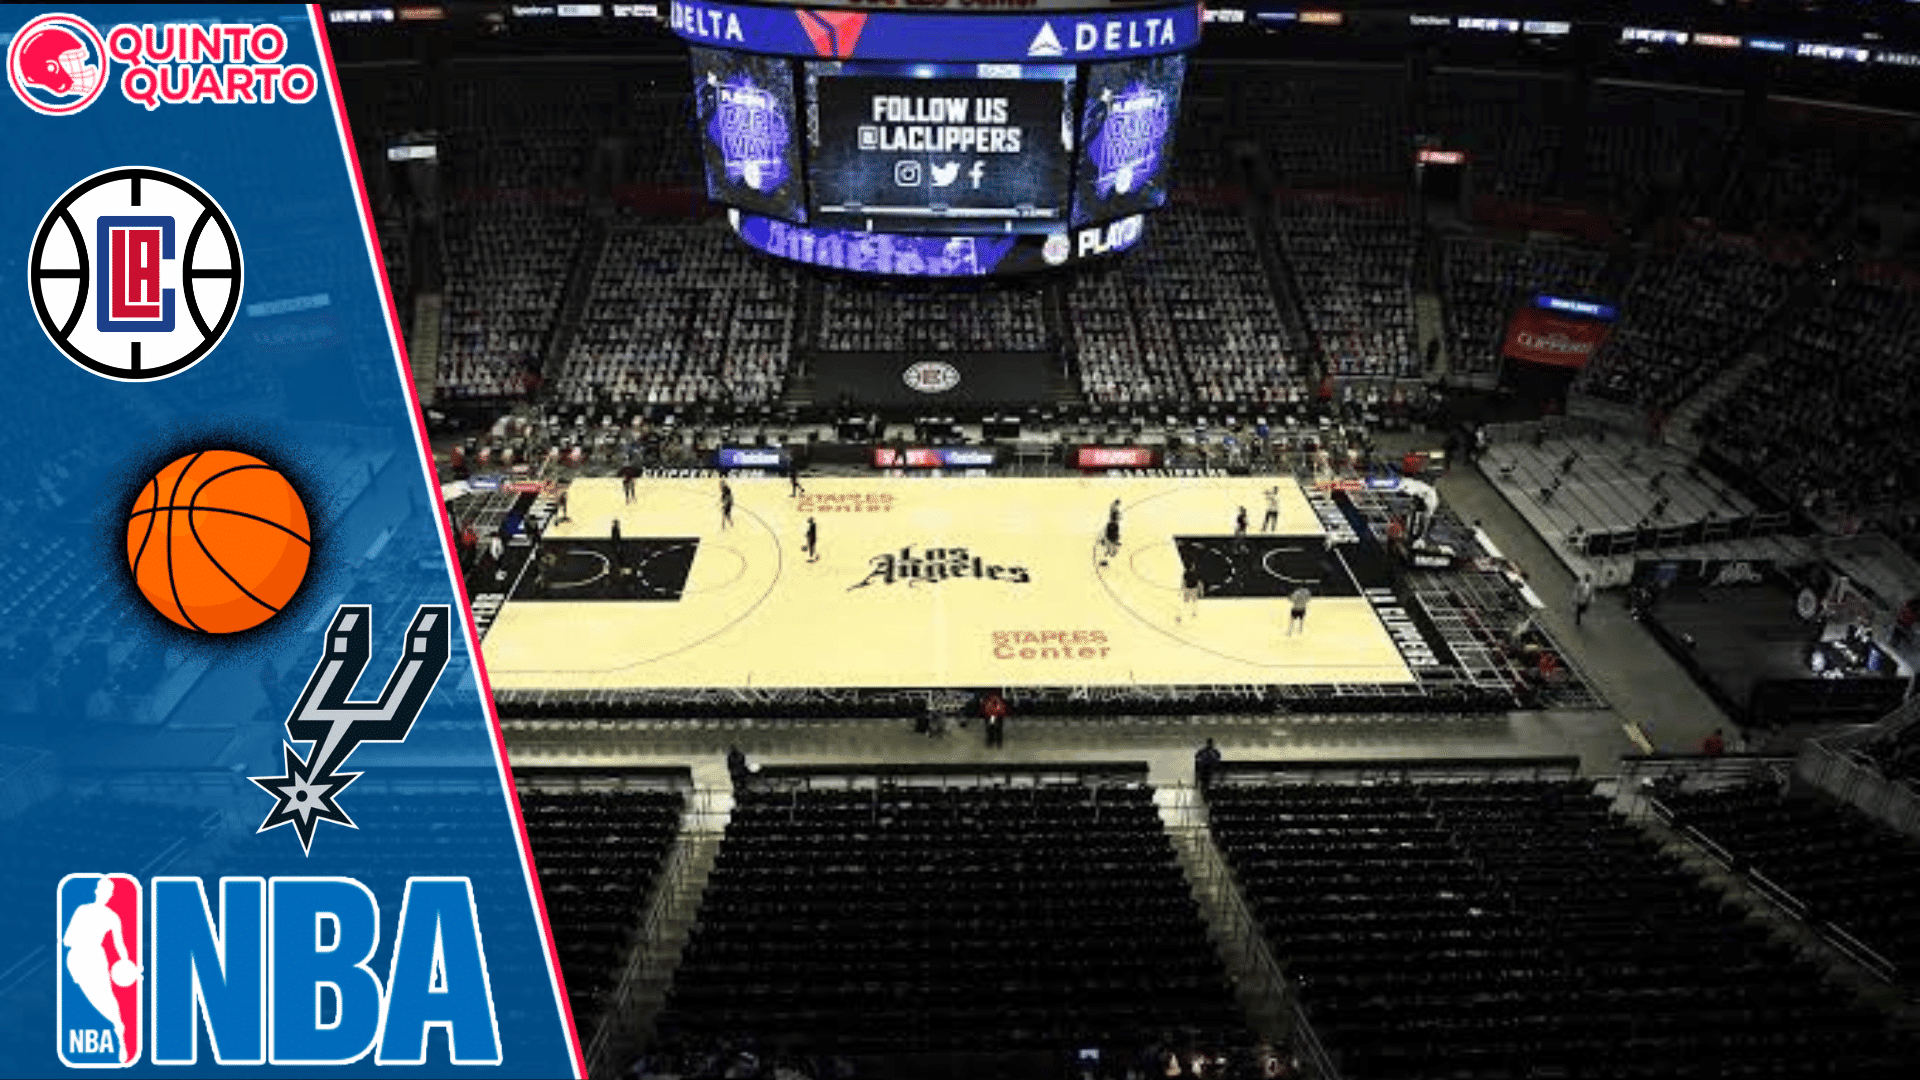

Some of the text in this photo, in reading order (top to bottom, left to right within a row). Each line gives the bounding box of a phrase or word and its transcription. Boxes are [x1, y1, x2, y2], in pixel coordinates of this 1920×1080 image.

[670, 1, 745, 42] DELTA
[1075, 18, 1175, 51] DELTA
[872, 95, 1008, 123] FOLLOW US
[857, 125, 1022, 153] @LACLIPPERS
[846, 553, 1030, 592] Angeles
[992, 630, 1108, 645] STAPLES
[993, 643, 1110, 660] Center
